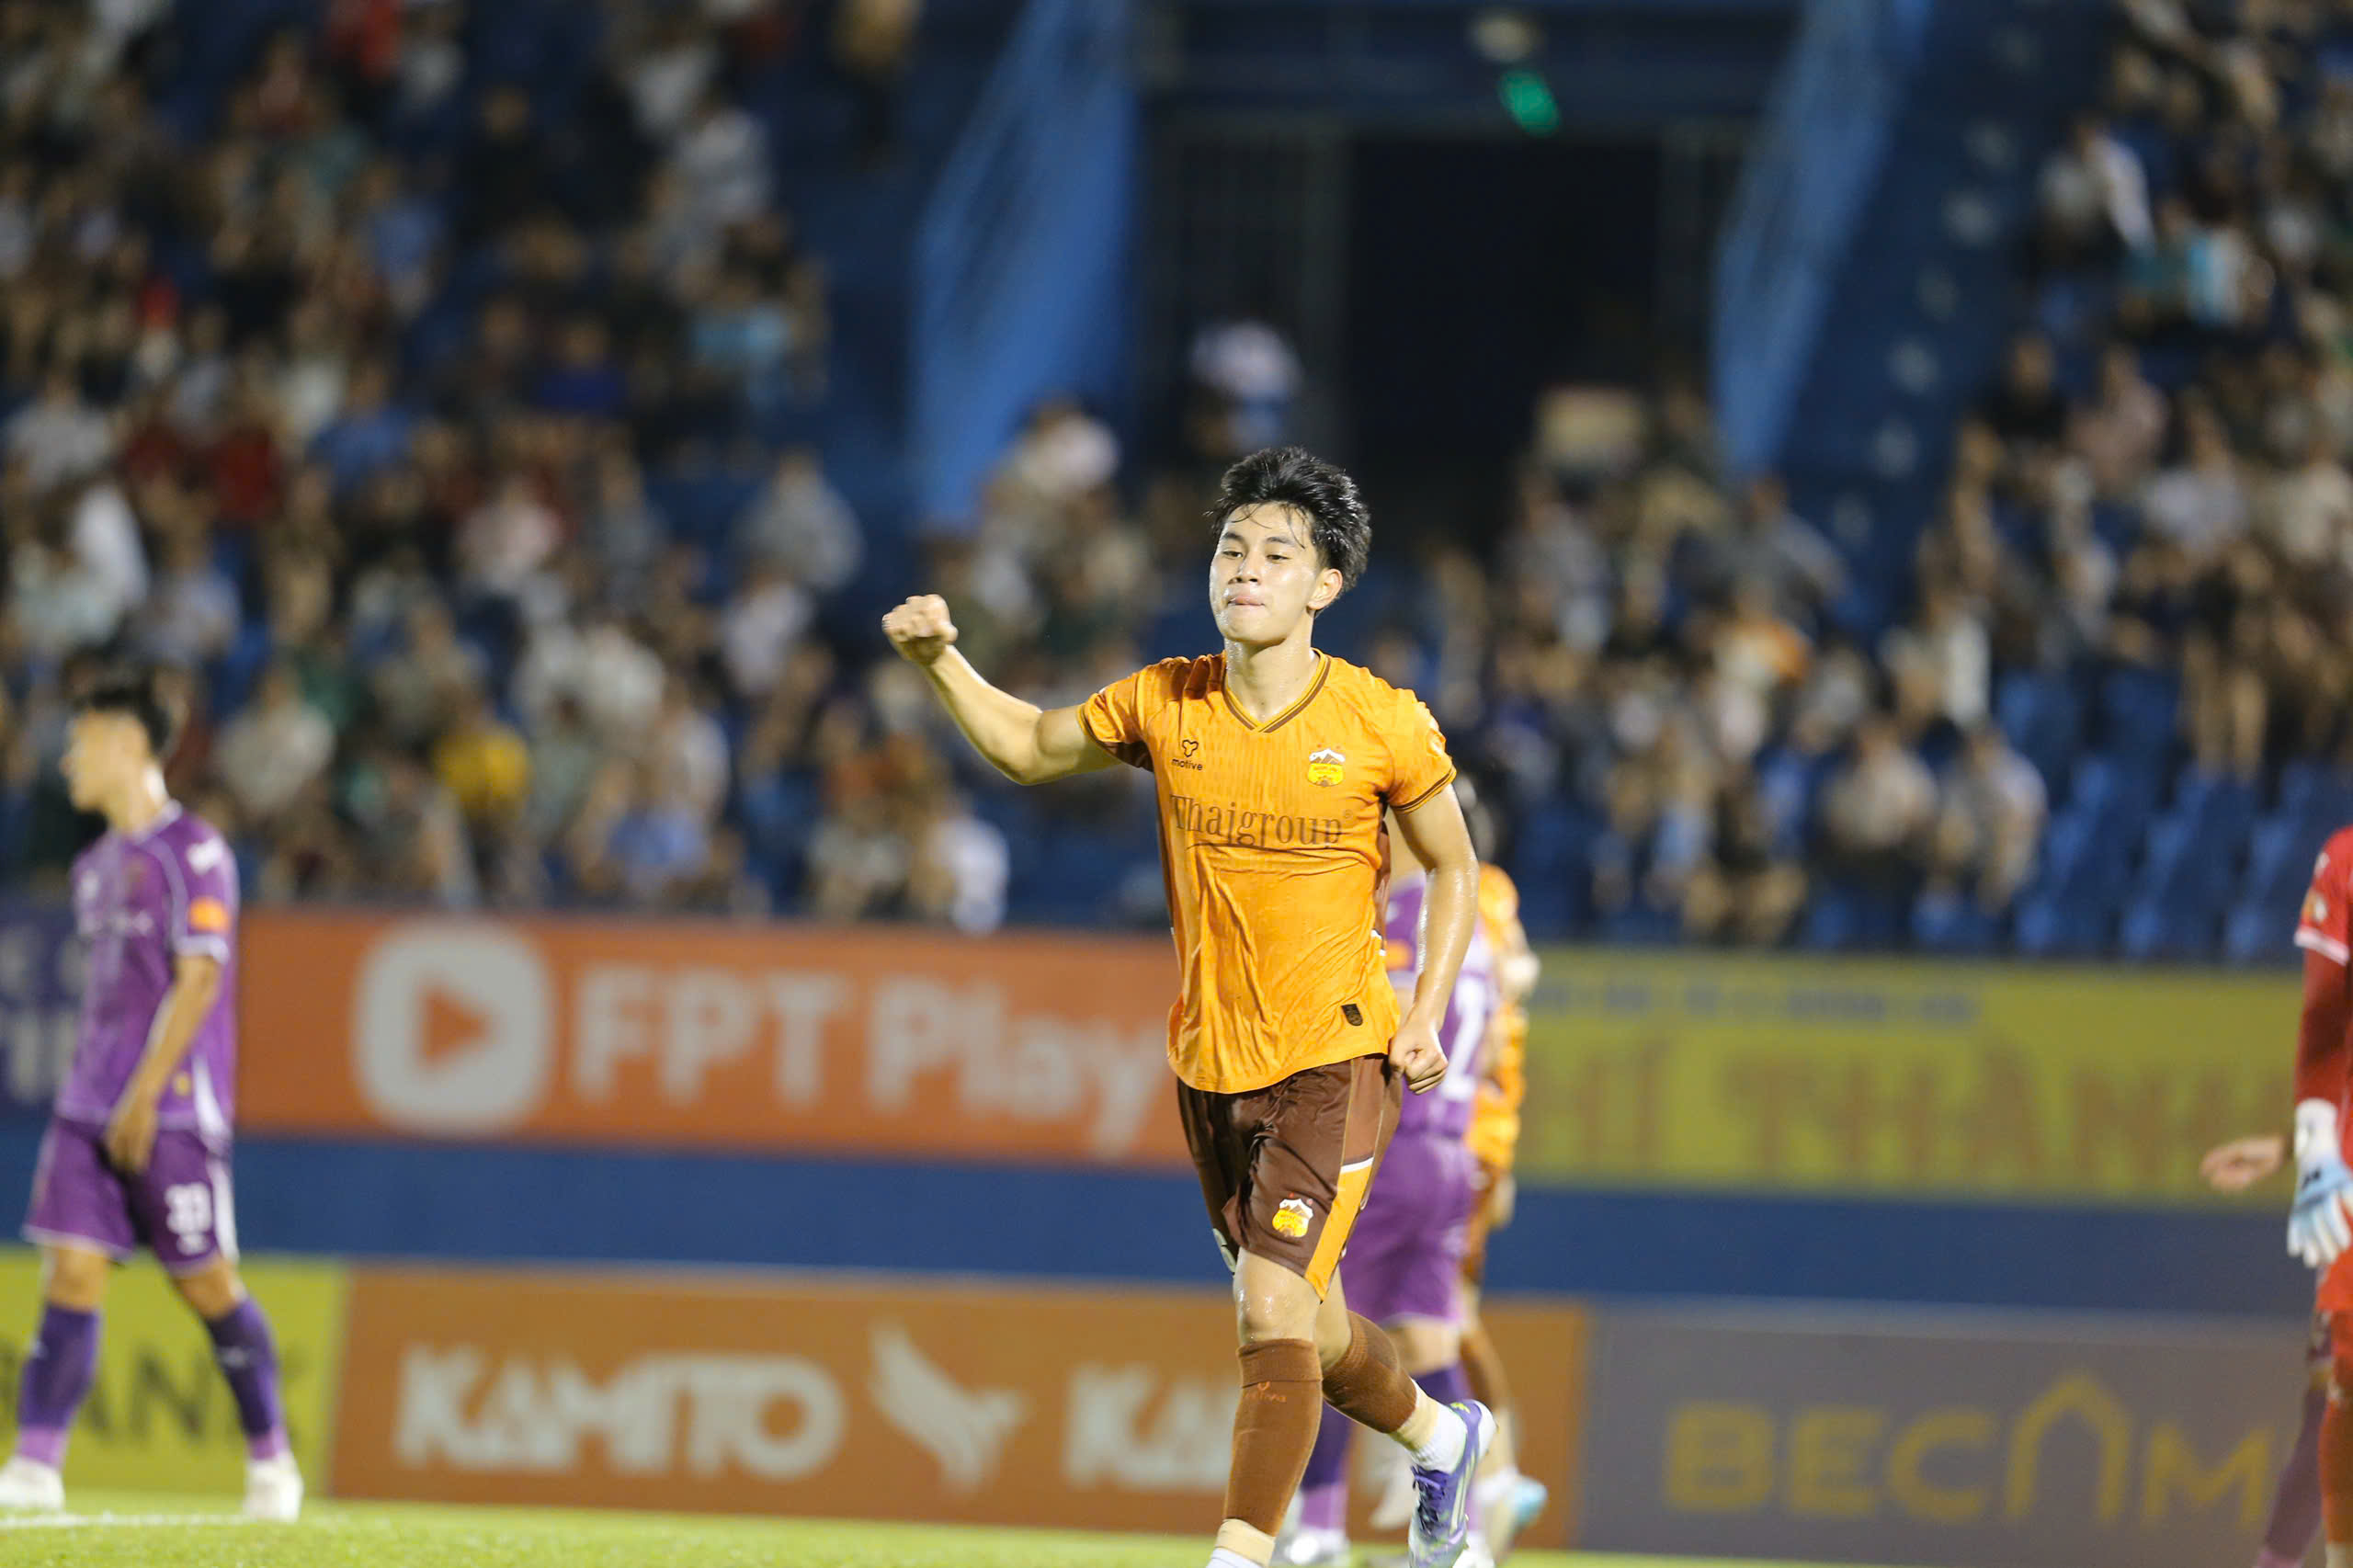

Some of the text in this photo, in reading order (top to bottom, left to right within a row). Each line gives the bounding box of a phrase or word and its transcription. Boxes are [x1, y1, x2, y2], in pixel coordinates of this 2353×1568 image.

[1170, 757, 1203, 771] motive
[1169, 794, 1343, 849] Thaigroup
[574, 963, 1165, 1158] FPT Play
